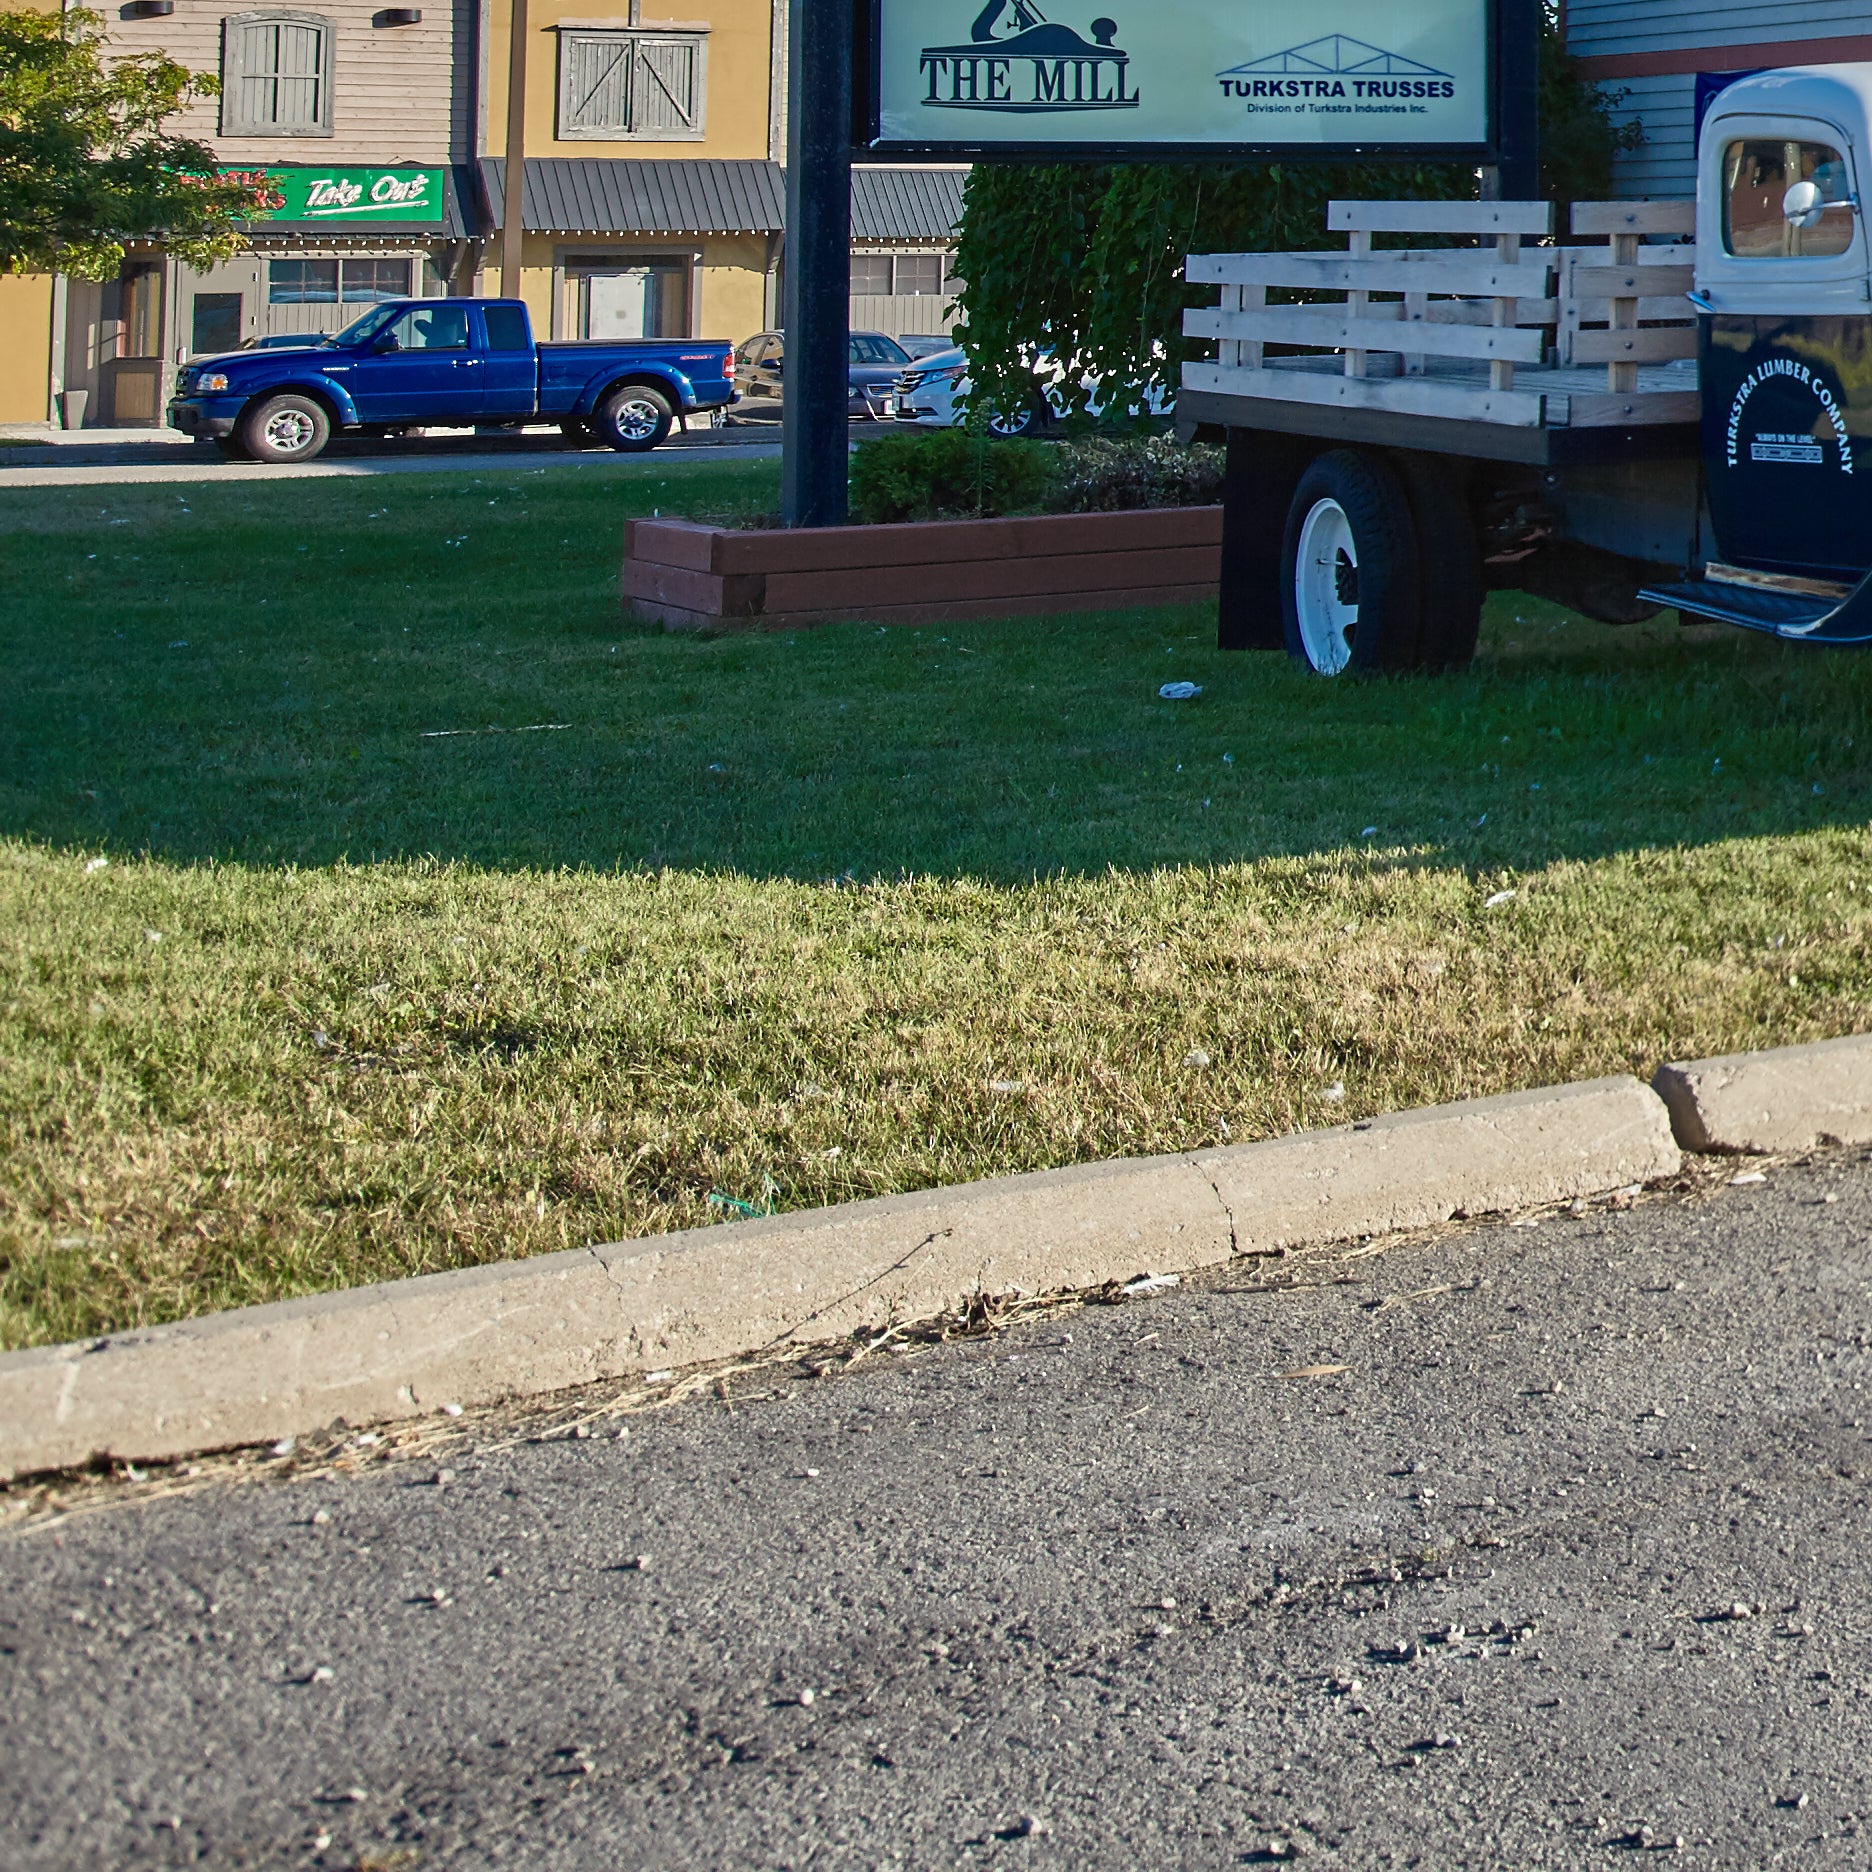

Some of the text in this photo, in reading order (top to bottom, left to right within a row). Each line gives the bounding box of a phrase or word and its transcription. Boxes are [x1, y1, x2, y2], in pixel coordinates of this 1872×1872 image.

[920, 58, 1140, 102] THE MILL
[1219, 79, 1455, 99] TURKSTRA TRUSSES
[1247, 103, 1429, 114] Division of Turkstra Industries Inc.
[304, 178, 363, 208] Take
[368, 174, 429, 203] Out
[1727, 359, 1853, 474] TURKSTRA LUMBER COMPANY
